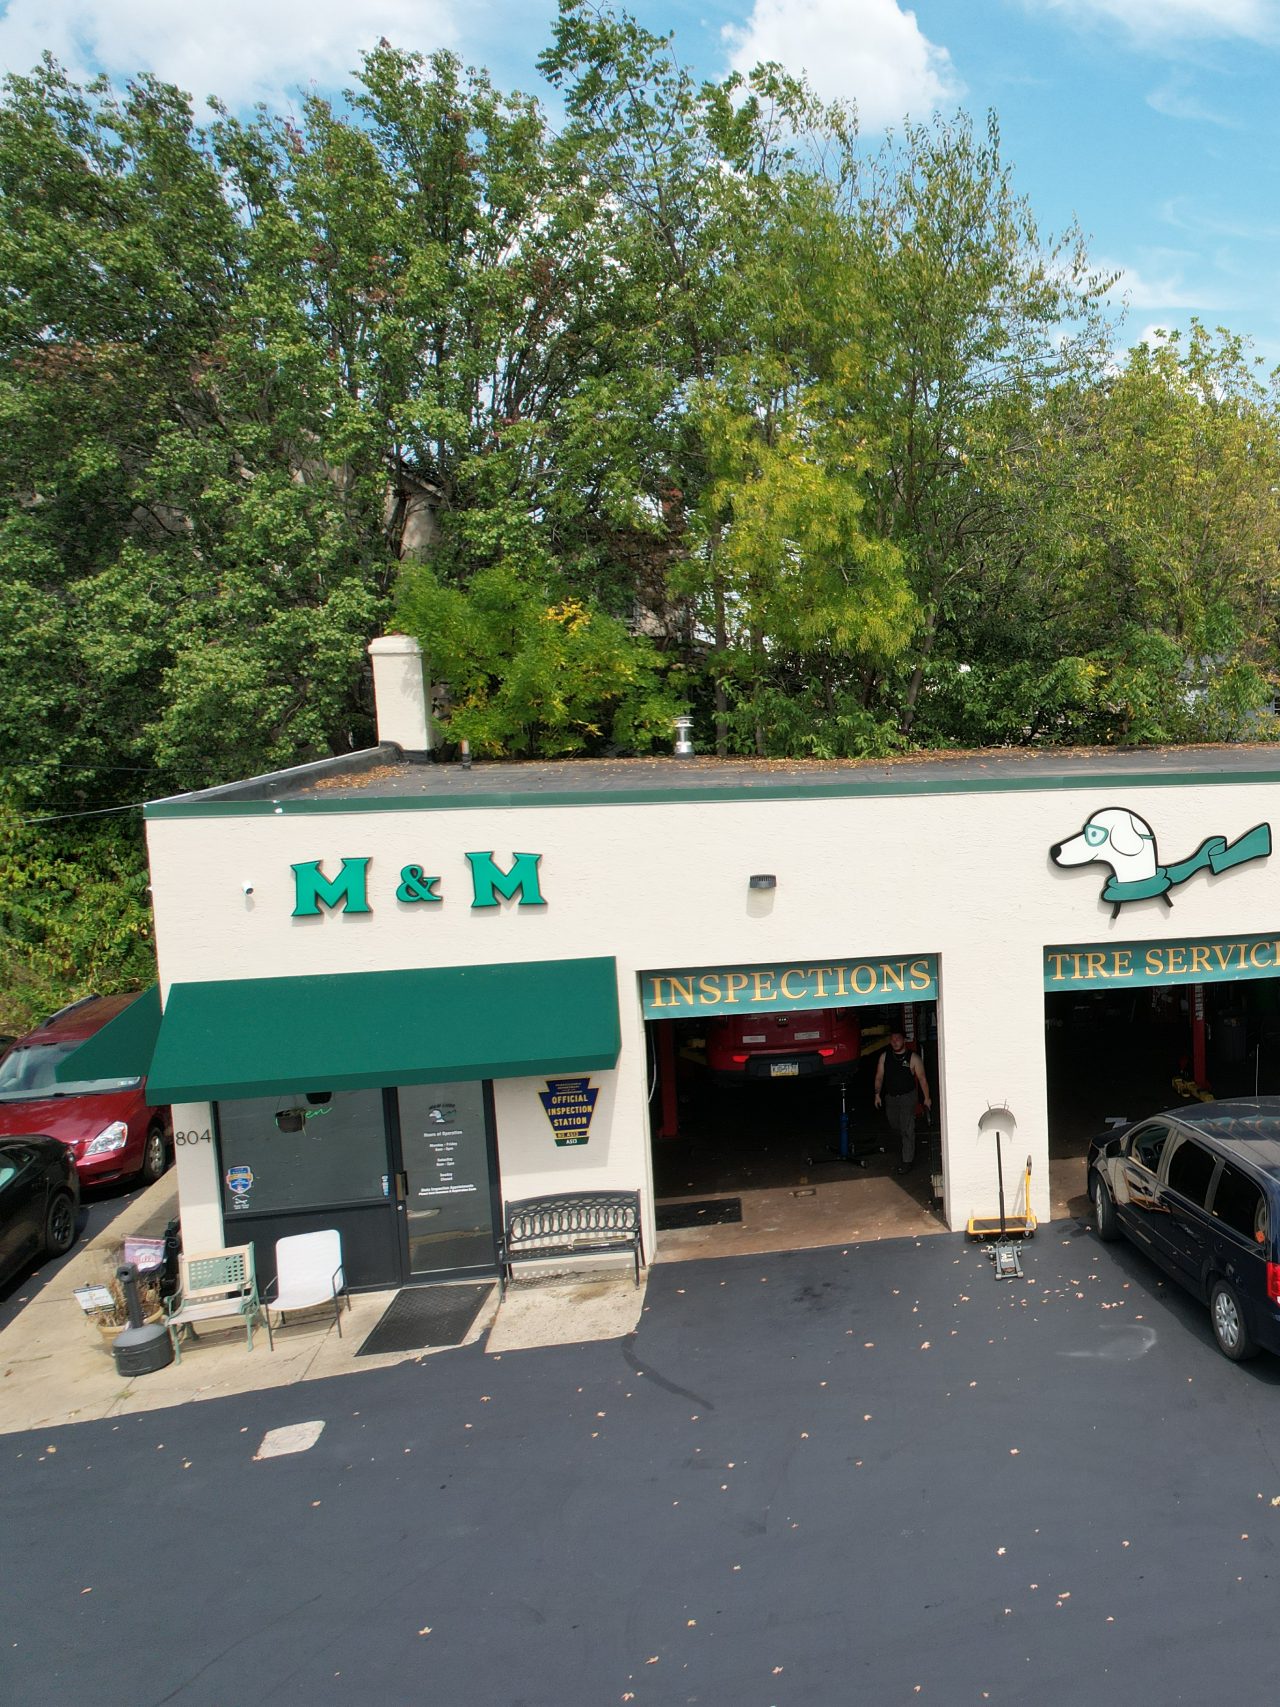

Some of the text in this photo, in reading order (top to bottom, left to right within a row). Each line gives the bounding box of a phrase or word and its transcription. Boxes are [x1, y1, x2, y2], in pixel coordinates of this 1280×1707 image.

[291, 851, 547, 916] M & M
[1048, 950, 1134, 980] TIRE
[649, 960, 931, 1007] INSPECTIONS
[551, 1094, 588, 1104] OFFICIAL
[548, 1105, 592, 1115] INSPECTION
[554, 1116, 587, 1126] STATION
[175, 1129, 211, 1146] 804
